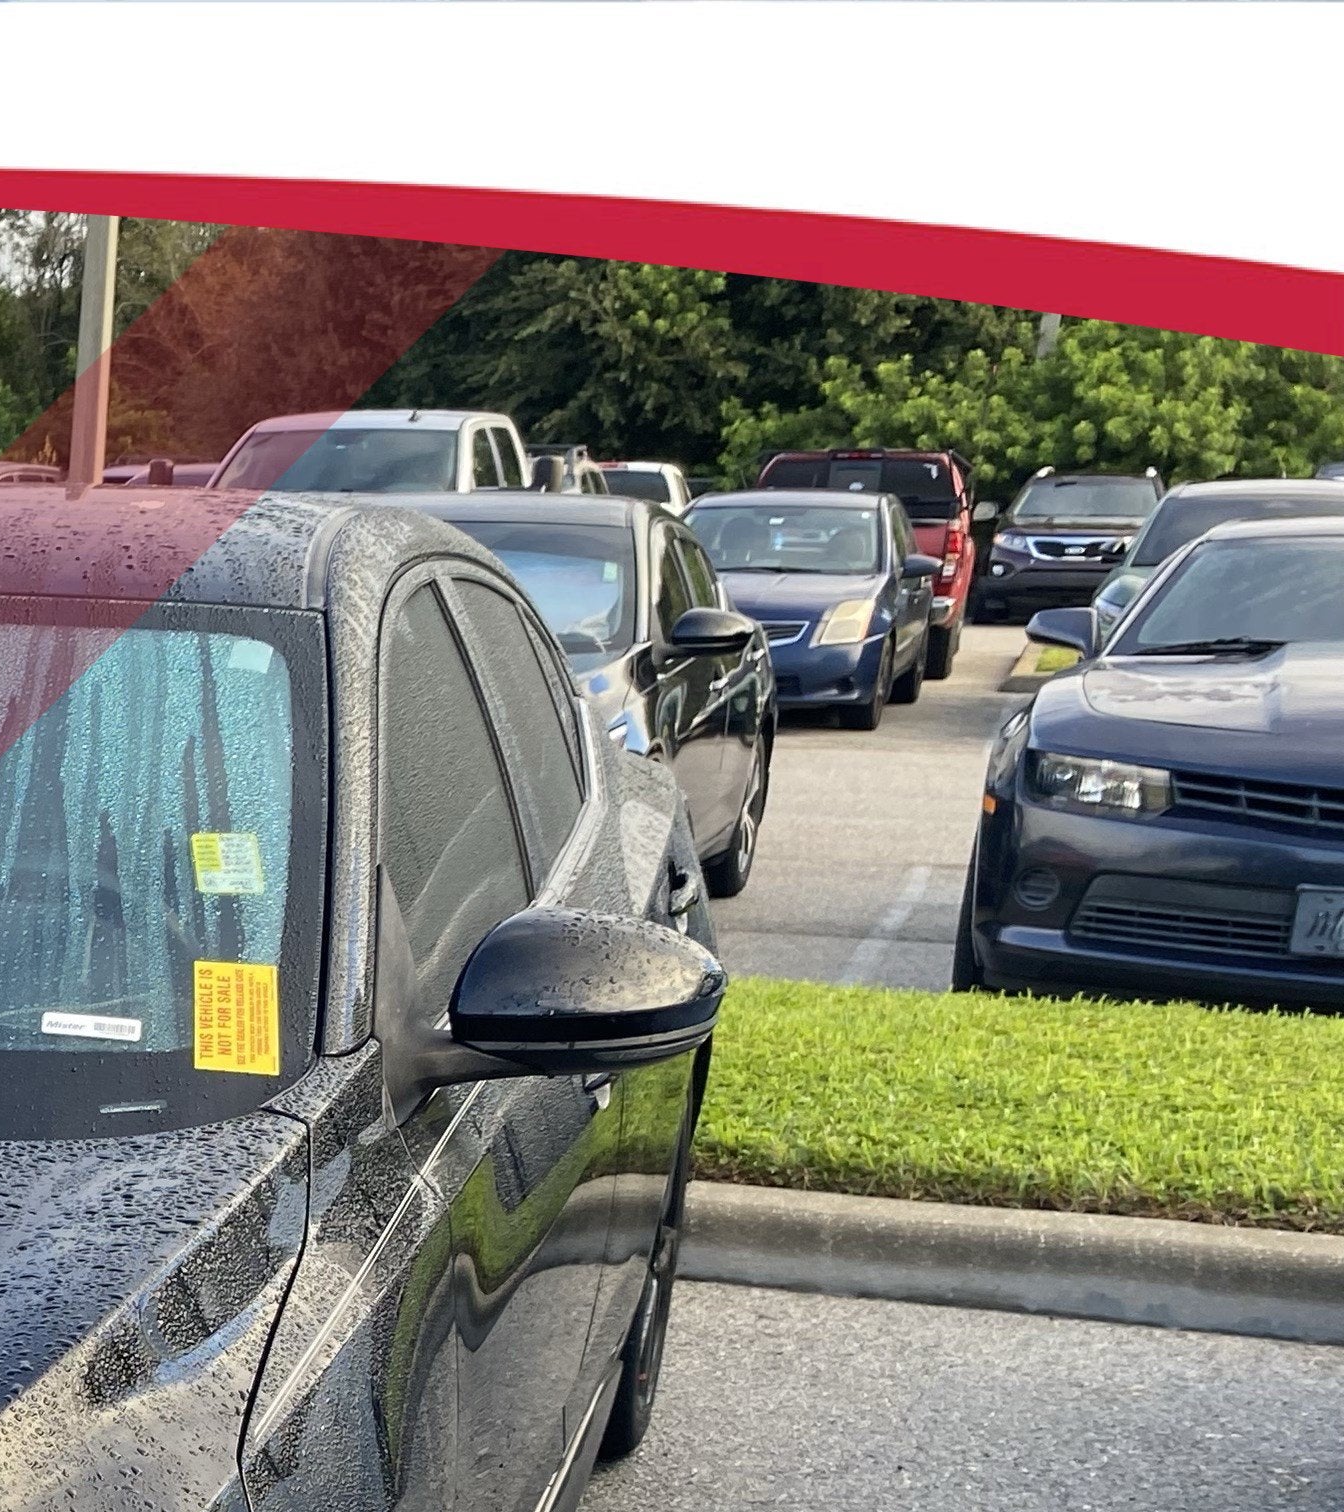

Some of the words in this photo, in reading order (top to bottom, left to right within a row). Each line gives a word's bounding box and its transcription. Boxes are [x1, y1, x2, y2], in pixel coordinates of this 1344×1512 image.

[198, 968, 213, 980] IS
[217, 975, 231, 1003] SALE
[199, 983, 213, 1029] VEHICLE
[217, 1007, 232, 1029] FOR
[199, 1032, 213, 1059] THIS
[217, 1032, 232, 1056] NOT
